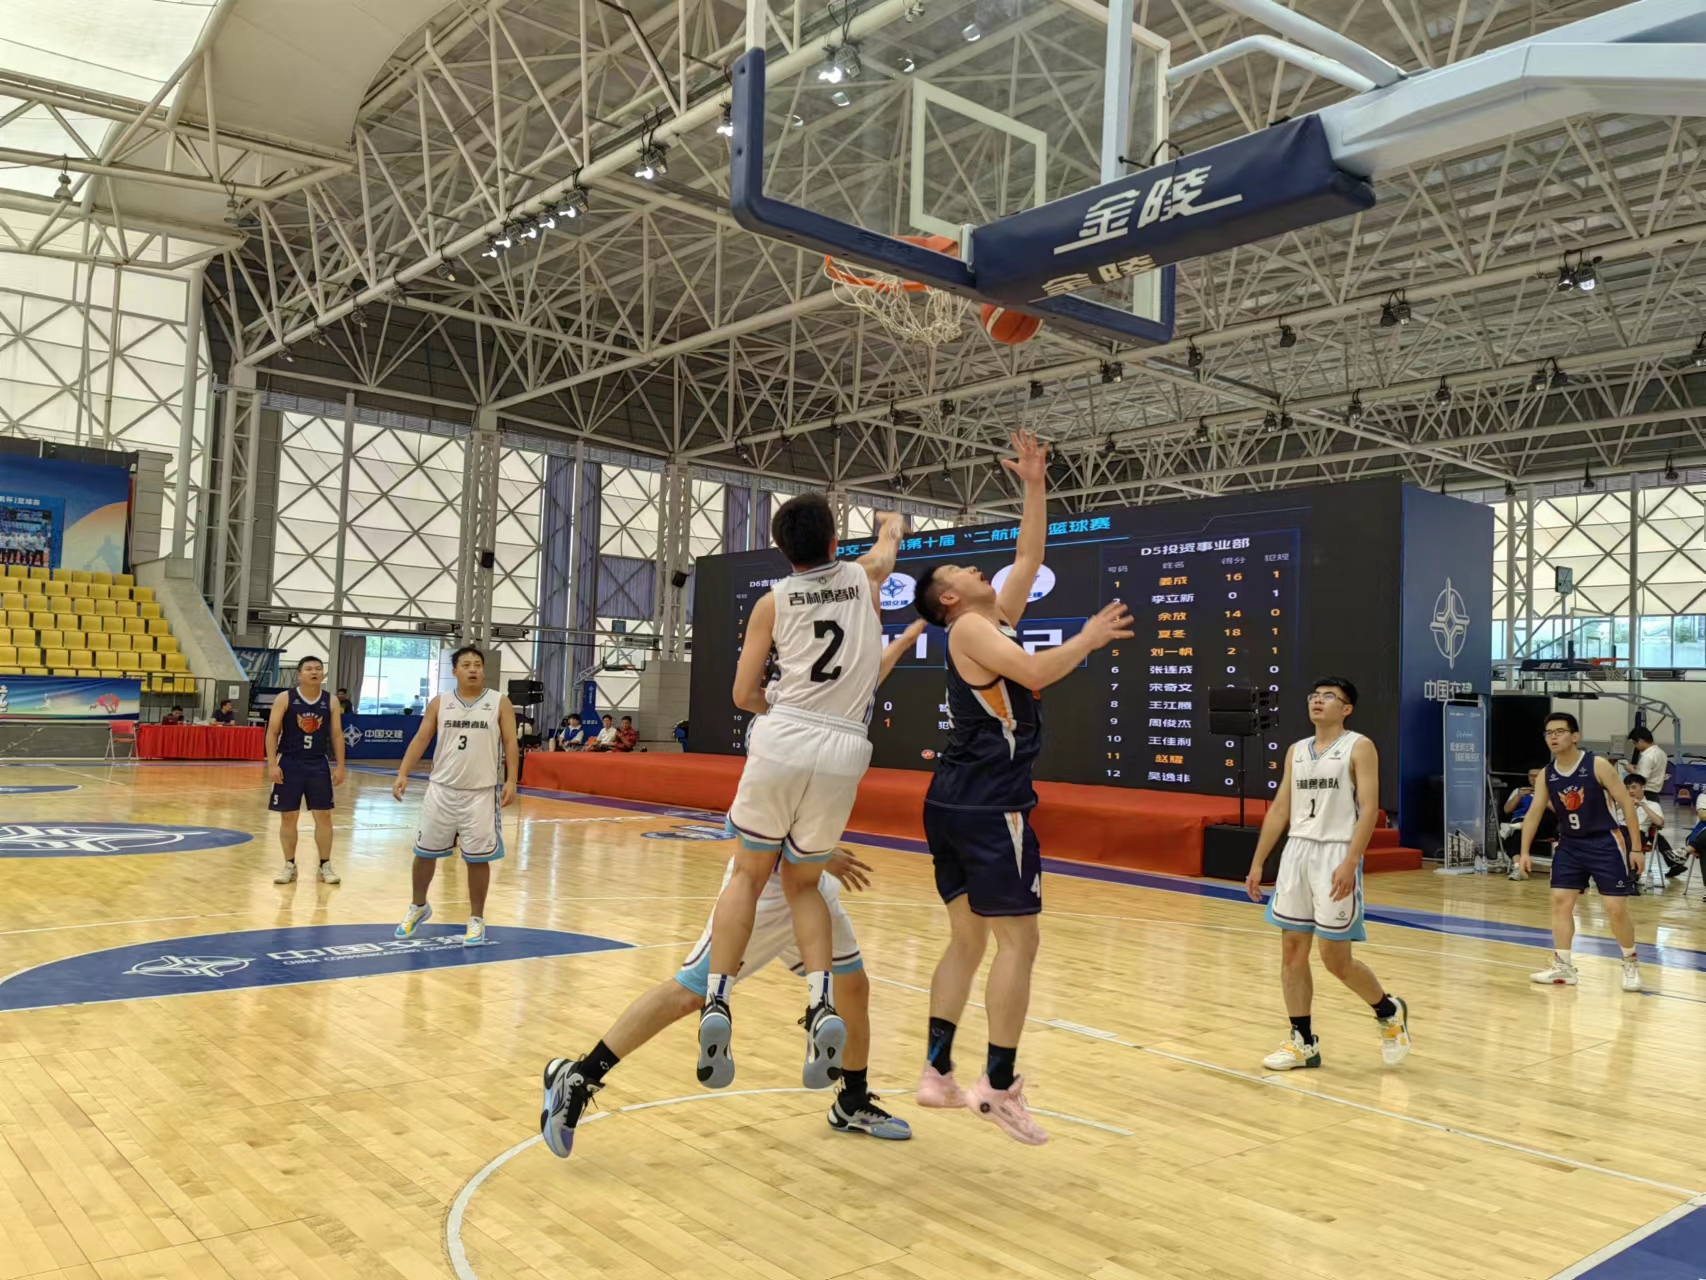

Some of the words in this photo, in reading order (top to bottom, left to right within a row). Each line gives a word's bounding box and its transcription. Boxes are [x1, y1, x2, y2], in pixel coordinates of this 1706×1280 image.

[1054, 165, 1243, 255] 金陵
[1140, 537, 1250, 556] D5投资事业部
[1162, 561, 1184, 569] 姓名
[1221, 556, 1246, 565] 得分
[1264, 553, 1290, 562] 犯规
[1225, 573, 1242, 581] 16
[1273, 570, 1280, 578] 1
[788, 586, 860, 606] 吉林勇者队
[1151, 593, 1195, 604] 李立新
[1228, 591, 1238, 599] 0
[1272, 589, 1279, 597] 1
[1224, 610, 1241, 618] 14
[1270, 608, 1280, 616] 0
[1224, 628, 1241, 636] 18
[1271, 627, 1278, 635] 1
[810, 620, 844, 683] 2
[1227, 647, 1237, 655] 2
[1111, 666, 1119, 674] 6
[1149, 665, 1193, 674] 张连成
[1226, 665, 1236, 673] 0
[1269, 665, 1279, 673] 0
[1110, 683, 1119, 691] 7
[1149, 683, 1193, 692] 宋奇文
[884, 702, 892, 711] 0
[1110, 700, 1119, 708] 8
[885, 719, 891, 728] 1
[1148, 718, 1192, 729] 周俊杰
[364, 729, 403, 739] 中国交建
[303, 736, 312, 749] 5
[457, 735, 468, 751] 3
[1147, 736, 1192, 747] 王佳利
[1225, 740, 1235, 748] 0
[1268, 742, 1278, 750] 0
[1106, 752, 1120, 760] 11
[1225, 759, 1234, 767] 8
[1268, 761, 1278, 769] 3
[1106, 769, 1121, 777] 12
[1224, 778, 1234, 786] 0
[1268, 780, 1277, 789] 0
[1309, 798, 1316, 818] 1
[1568, 813, 1581, 830] 9
[1030, 872, 1040, 898] 4
[283, 958, 320, 966] CHINA
